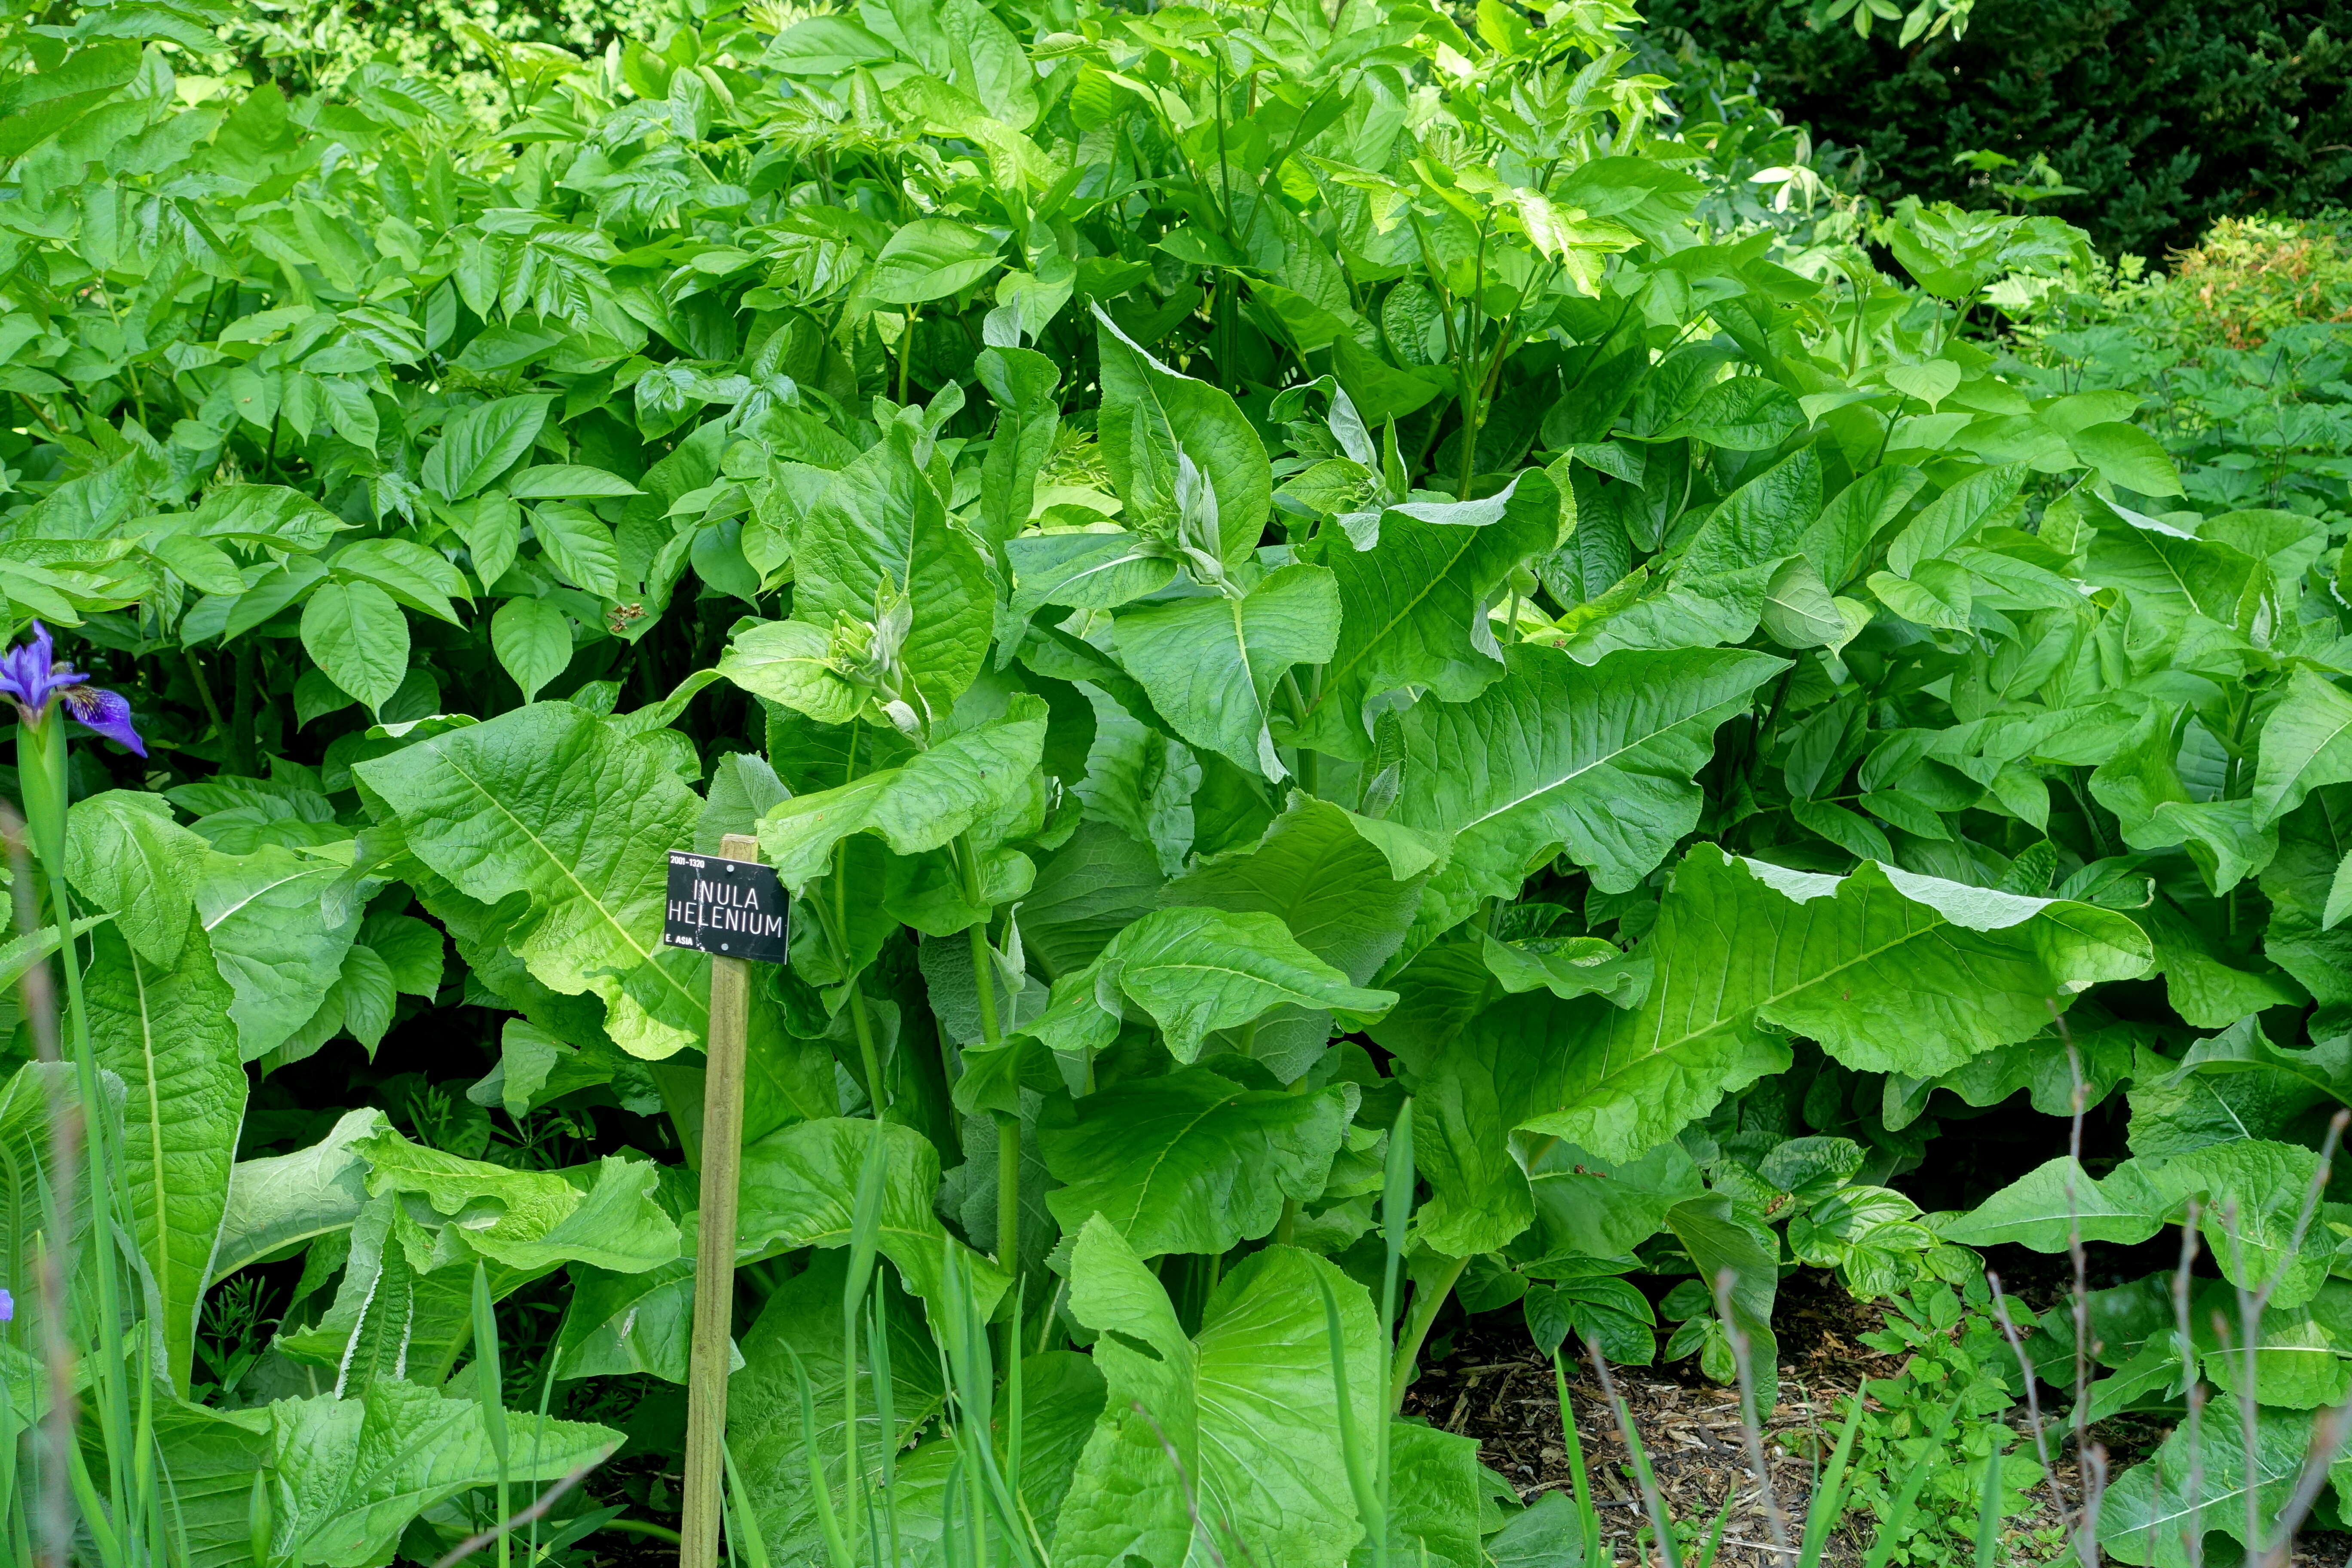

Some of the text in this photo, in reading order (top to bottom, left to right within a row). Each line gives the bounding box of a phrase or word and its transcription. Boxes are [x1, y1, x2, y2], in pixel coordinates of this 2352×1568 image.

[671, 856, 704, 868] 2001-1320
[694, 879, 758, 910] INULA
[669, 900, 782, 937] HELENIUM
[666, 934, 693, 945] E. ASIA
